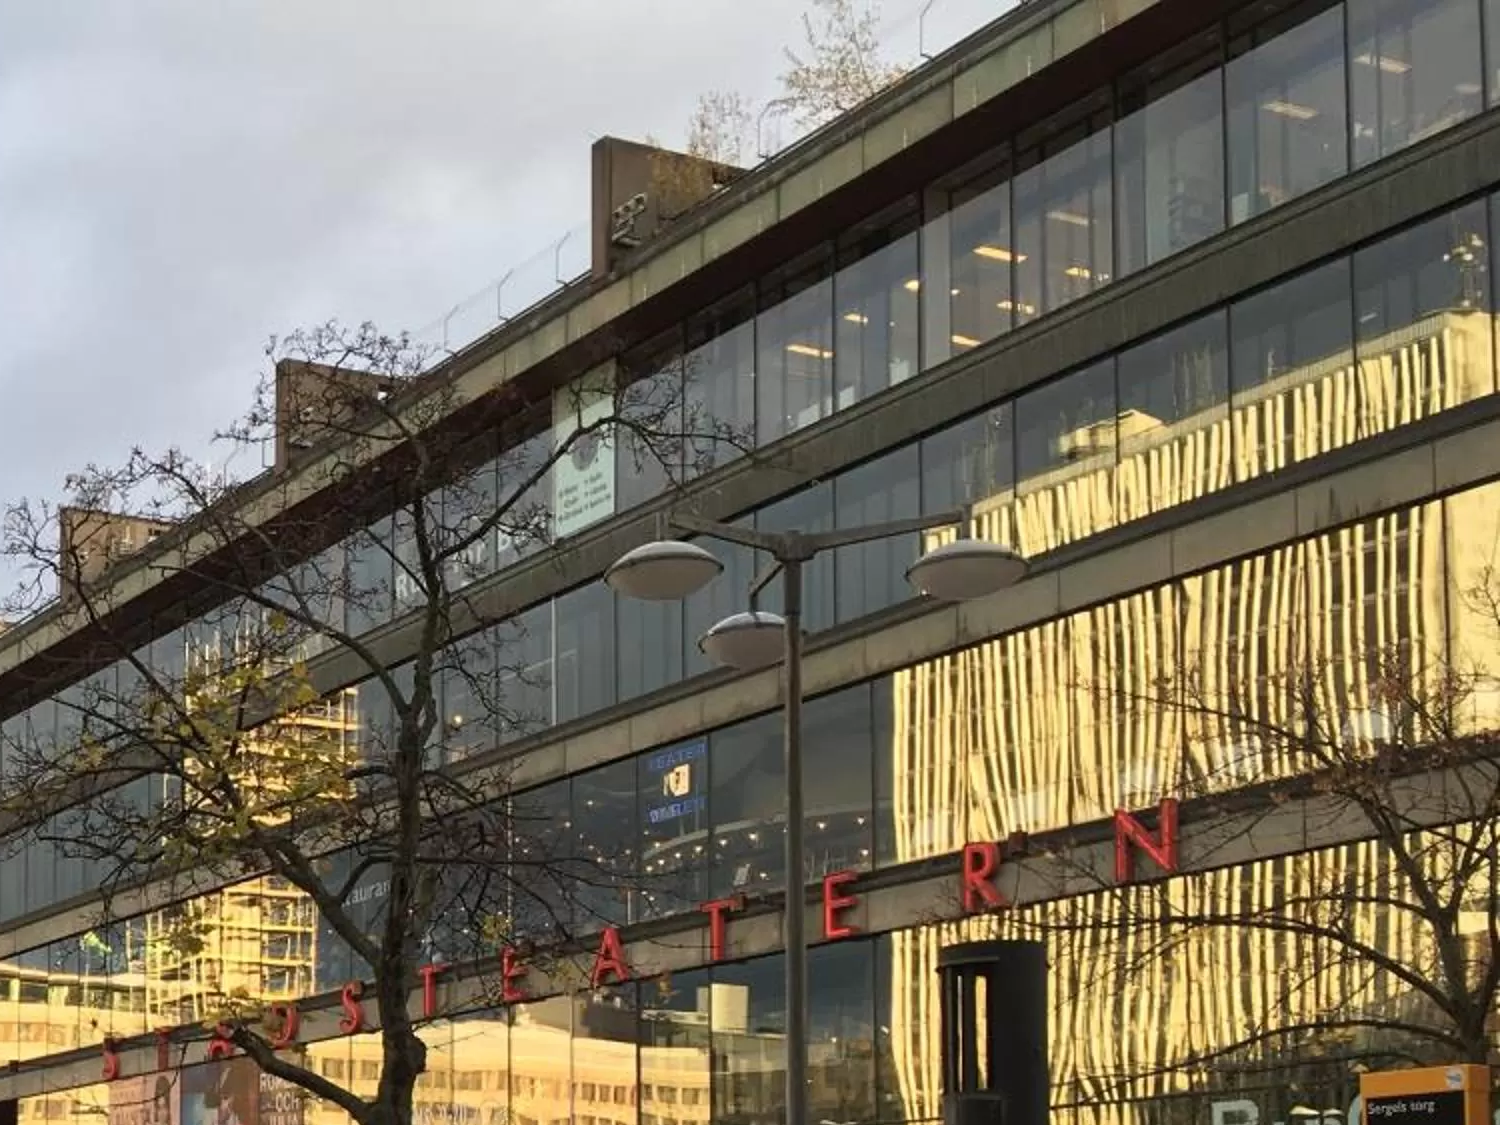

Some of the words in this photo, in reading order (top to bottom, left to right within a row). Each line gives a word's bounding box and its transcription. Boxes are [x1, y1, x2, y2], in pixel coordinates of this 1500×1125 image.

[275, 1092, 299, 1112] OCH
[1367, 1102, 1407, 1117] Sergels
[1411, 1101, 1436, 1114] torg
